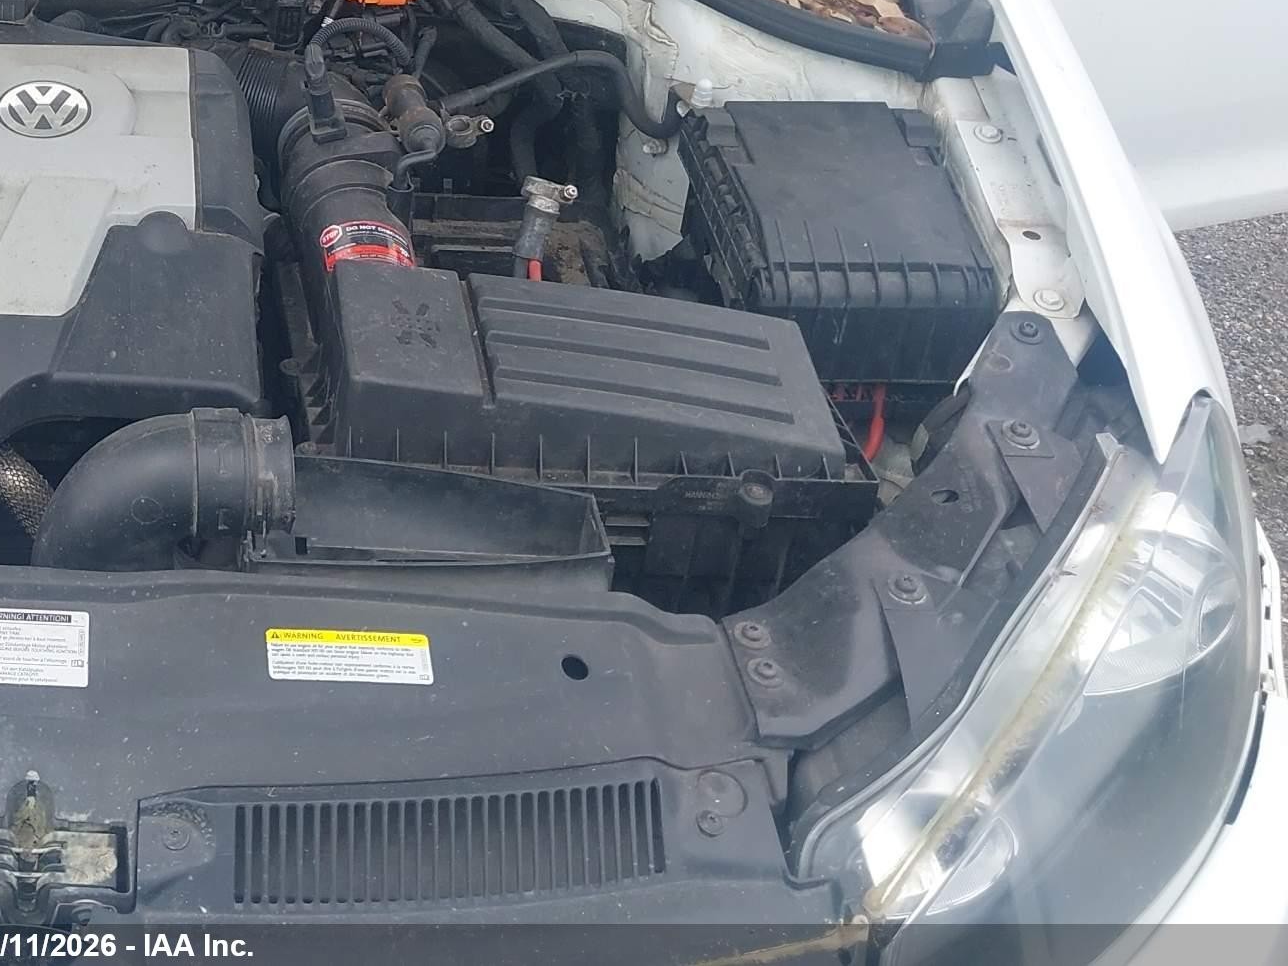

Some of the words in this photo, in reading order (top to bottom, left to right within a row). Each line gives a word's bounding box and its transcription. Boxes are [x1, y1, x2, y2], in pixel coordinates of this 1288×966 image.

[322, 228, 339, 244] STOP
[25, 613, 70, 622] ATTENTION!
[283, 632, 324, 640] WARNING
[336, 634, 401, 643] AVERTISSEMENT
